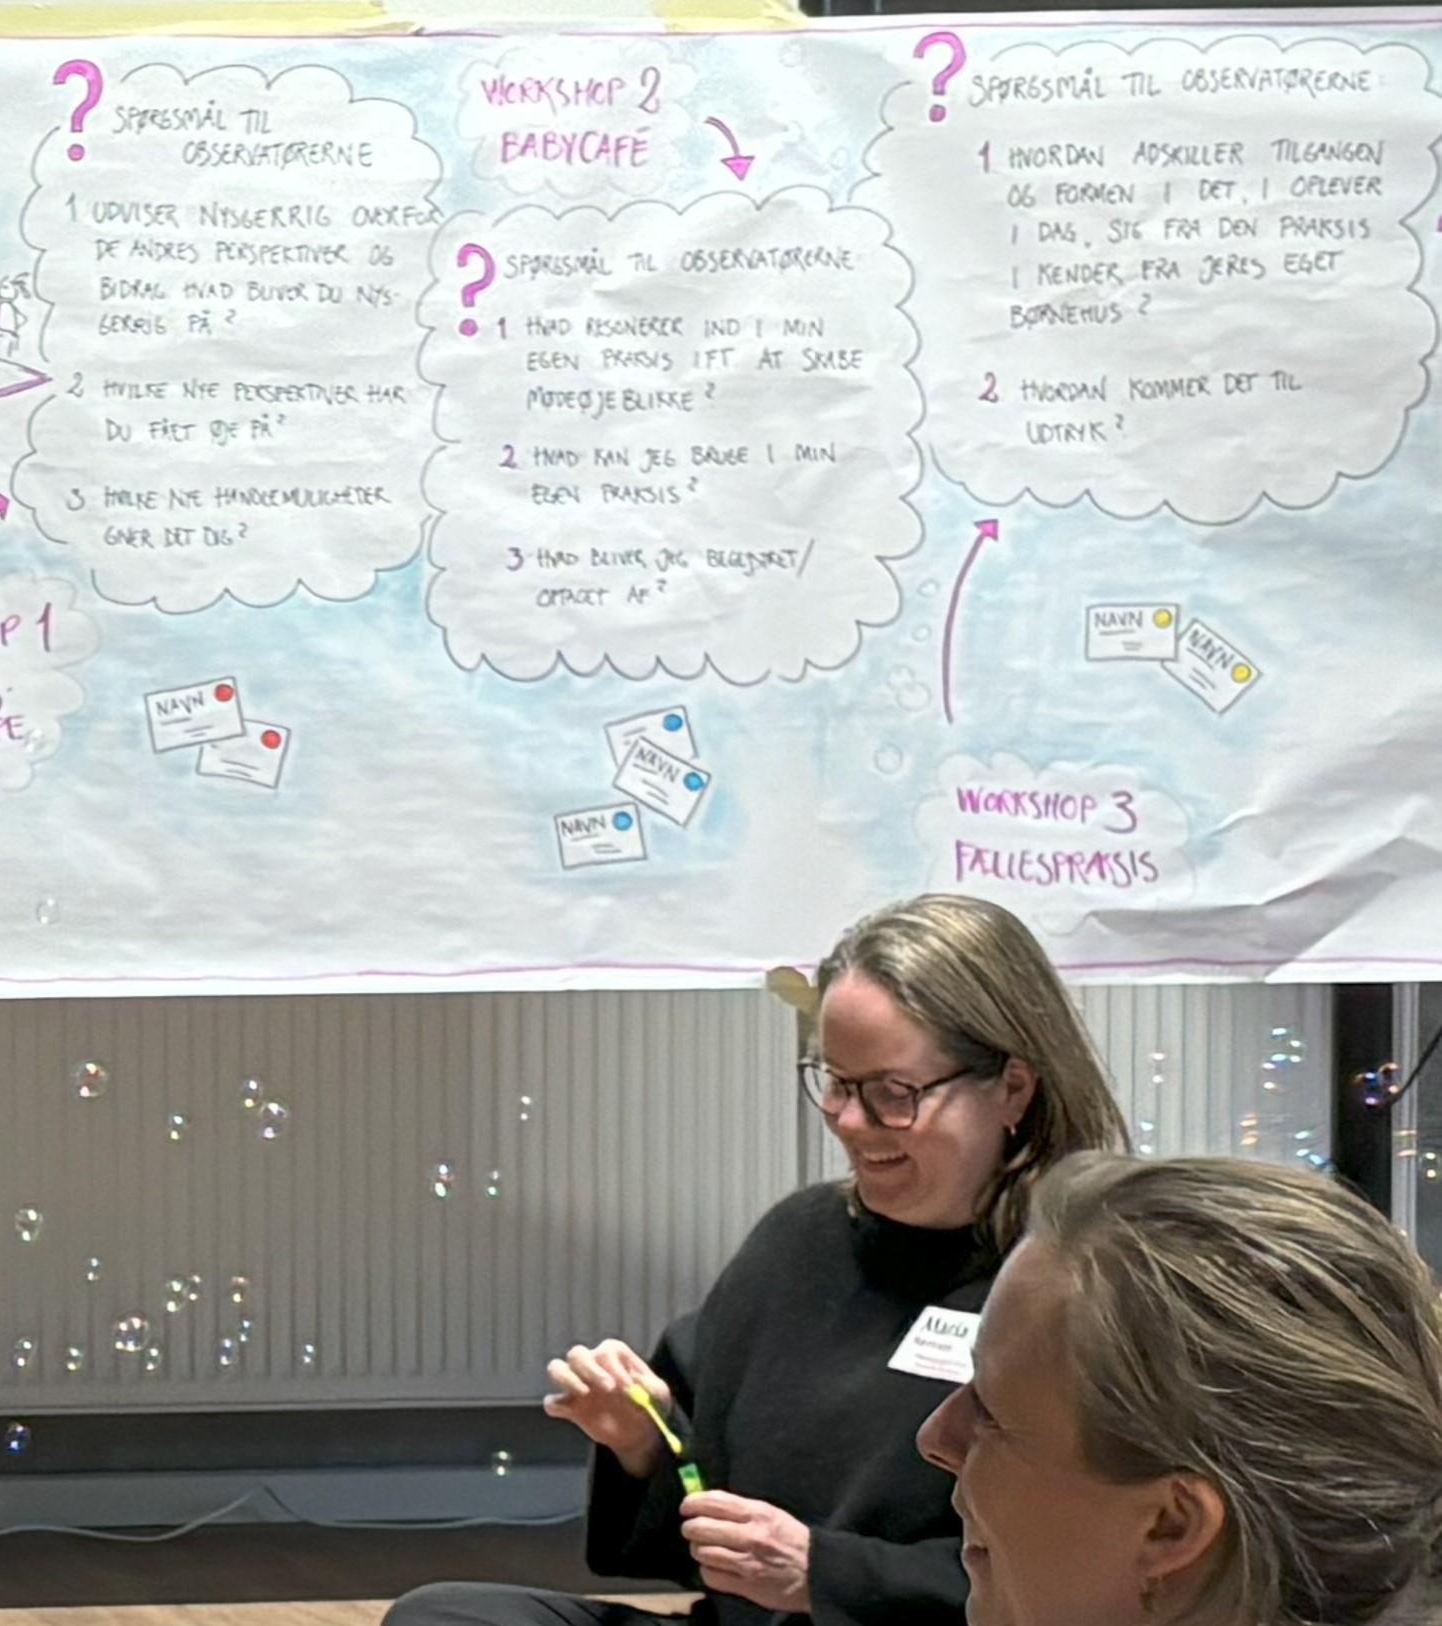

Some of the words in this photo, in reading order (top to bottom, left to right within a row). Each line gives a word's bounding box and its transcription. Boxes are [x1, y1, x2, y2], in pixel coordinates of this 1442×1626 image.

[480, 77, 625, 116] WORKSHOP
[637, 65, 662, 114] 2
[969, 67, 1106, 107] SPØRGSMÅL
[1121, 72, 1162, 97] TIL
[242, 108, 272, 133] TIL
[500, 126, 650, 168] BABYCAFÉ
[1008, 141, 1105, 169] HVORDAN
[1132, 140, 1245, 168] ADSKILLER
[1272, 138, 1385, 167] TILGANGEN
[1007, 183, 1037, 210] OG
[1055, 181, 1136, 207] FORMEN
[1290, 175, 1384, 199] OPLEVER
[199, 201, 331, 230] NYSGERRIG
[1106, 218, 1144, 244] SIG
[1163, 217, 1201, 241] FRA
[1218, 215, 1258, 240] DEN
[1279, 215, 1372, 241] PRAKSIS
[94, 238, 116, 262] DE
[130, 240, 201, 264] ANDRES
[368, 244, 395, 268] OG
[629, 253, 659, 274] TIL
[1037, 261, 1120, 287] KENDER
[1142, 257, 1180, 280] FRA
[1198, 255, 1267, 284] JERES
[1284, 250, 1344, 274] EGET
[183, 278, 239, 301] HVAD
[317, 281, 343, 303] DU
[704, 318, 741, 338] IND
[782, 318, 825, 337] MIN
[757, 349, 784, 370] AT
[67, 371, 84, 398] 2
[979, 371, 999, 404] 2
[1021, 374, 1107, 403] HVORDAN
[1129, 372, 1212, 400] KOMMER
[1224, 372, 1259, 394] DET
[1272, 370, 1304, 391] TIL
[105, 417, 132, 442] DU
[1026, 421, 1107, 445] UDTRYK
[498, 444, 518, 469] 2
[593, 448, 630, 467] KAN
[794, 442, 836, 463] MIN
[66, 488, 86, 511] 3
[35, 602, 53, 652] 1
[1094, 611, 1143, 629] NAVN
[1188, 628, 1234, 671] NAVN
[155, 691, 206, 717] NAVN
[635, 747, 680, 784] NAVN
[956, 786, 1097, 825] WORKSHOP
[1103, 790, 1138, 834] 3
[560, 814, 606, 837] NAVN
